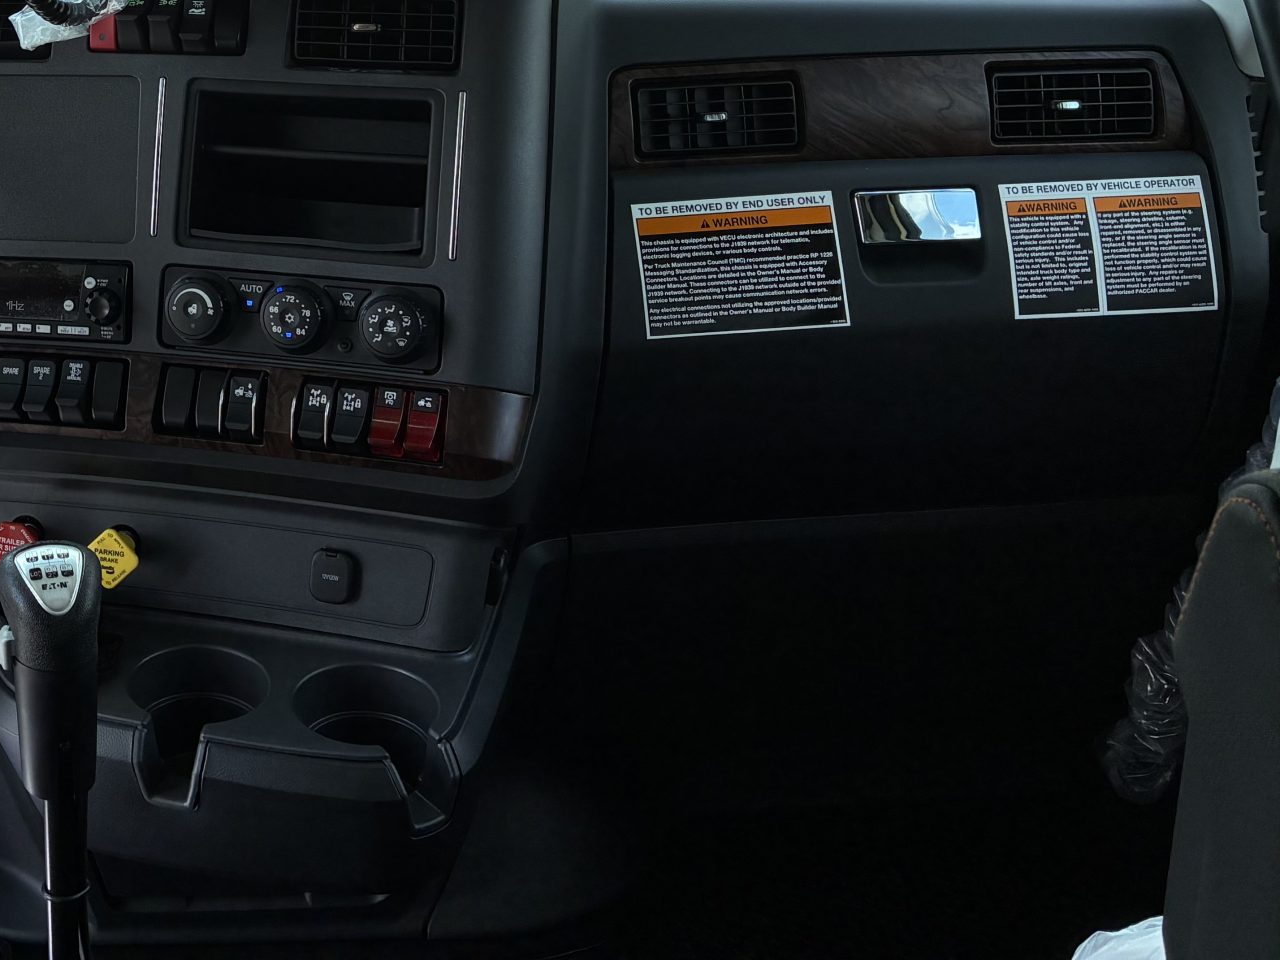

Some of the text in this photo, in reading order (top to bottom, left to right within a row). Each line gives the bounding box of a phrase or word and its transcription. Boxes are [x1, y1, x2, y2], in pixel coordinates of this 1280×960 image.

[1022, 186, 1034, 194] BE
[1036, 183, 1084, 193] REMOVED
[1086, 182, 1100, 190] BY
[1100, 180, 1142, 190] VEHICLE
[1144, 178, 1196, 188] OPERATOR
[638, 195, 826, 215] TO BE REMOVED BY END USER ONLY
[1126, 196, 1178, 208] WARNING
[1025, 202, 1077, 212] WARNING
[711, 215, 768, 227] WARNING
[240, 284, 263, 293] AUTO
[269, 306, 279, 314] 66
[301, 309, 311, 317] 78
[2, 367, 19, 375] SPARE
[33, 366, 51, 374] SPARE
[94, 548, 125, 557] PARKING
